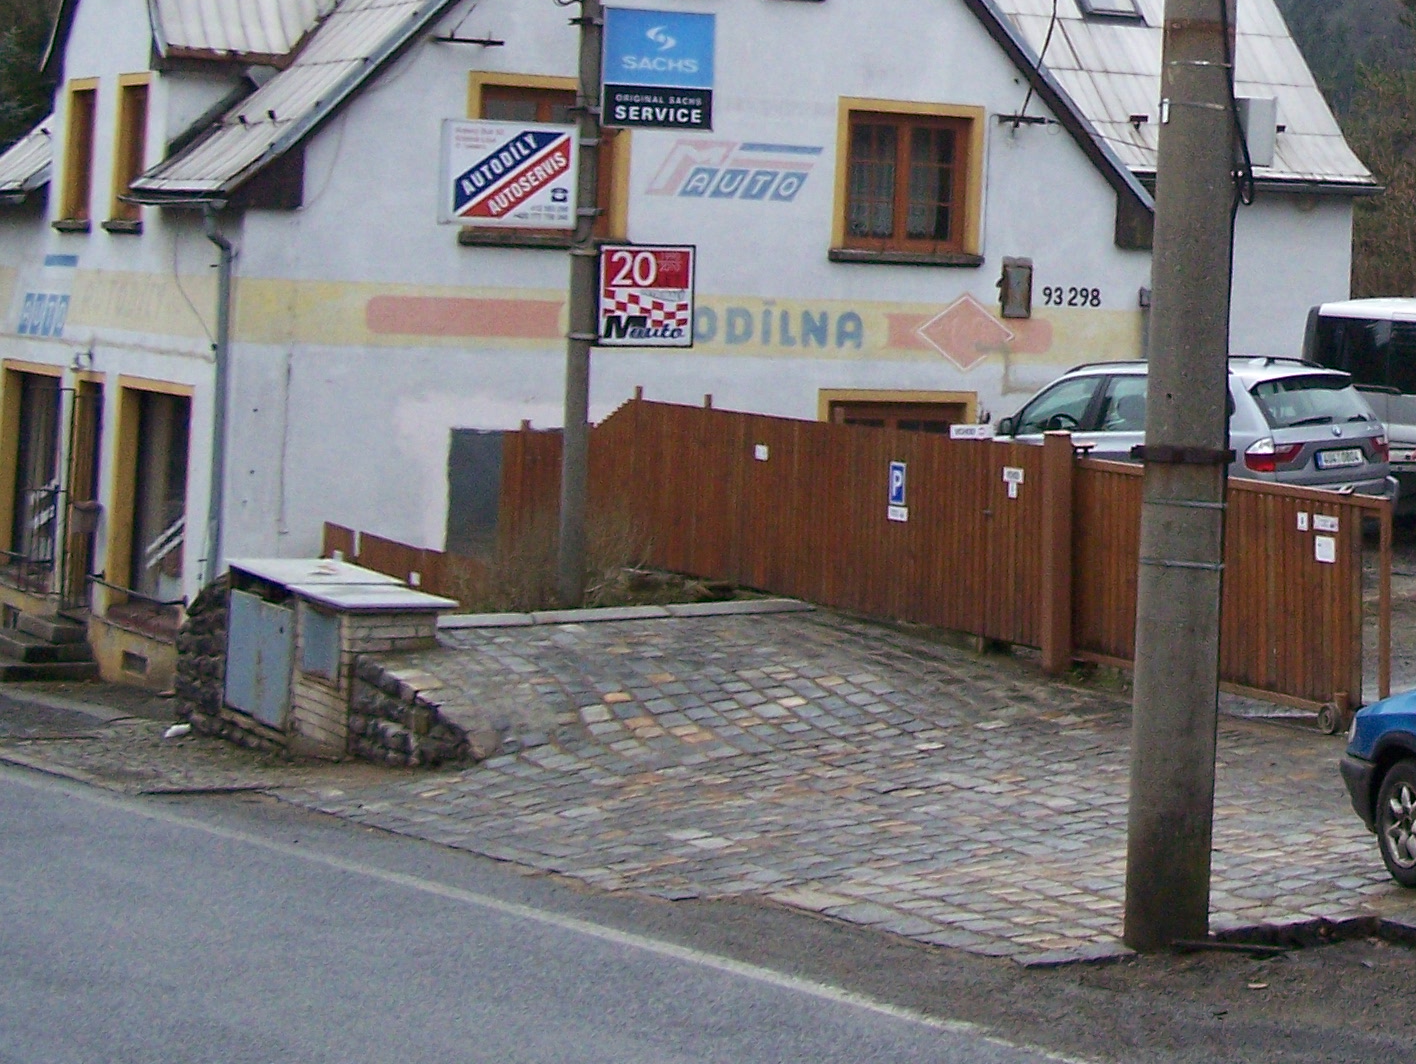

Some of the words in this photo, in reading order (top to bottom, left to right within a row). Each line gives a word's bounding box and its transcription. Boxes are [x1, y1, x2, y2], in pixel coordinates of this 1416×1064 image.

[621, 56, 699, 73] SACHS
[615, 93, 664, 104] ORIGINAL
[669, 96, 702, 106] SACHS
[615, 105, 702, 124] SERVICE
[460, 133, 538, 196] AUTODÍLY
[487, 151, 567, 215] AUTOSERVIS
[611, 251, 657, 286] 20
[1042, 286, 1063, 305] 93
[1067, 287, 1101, 307] 298
[694, 298, 864, 349] ODÍLNA
[892, 470, 902, 496] P
